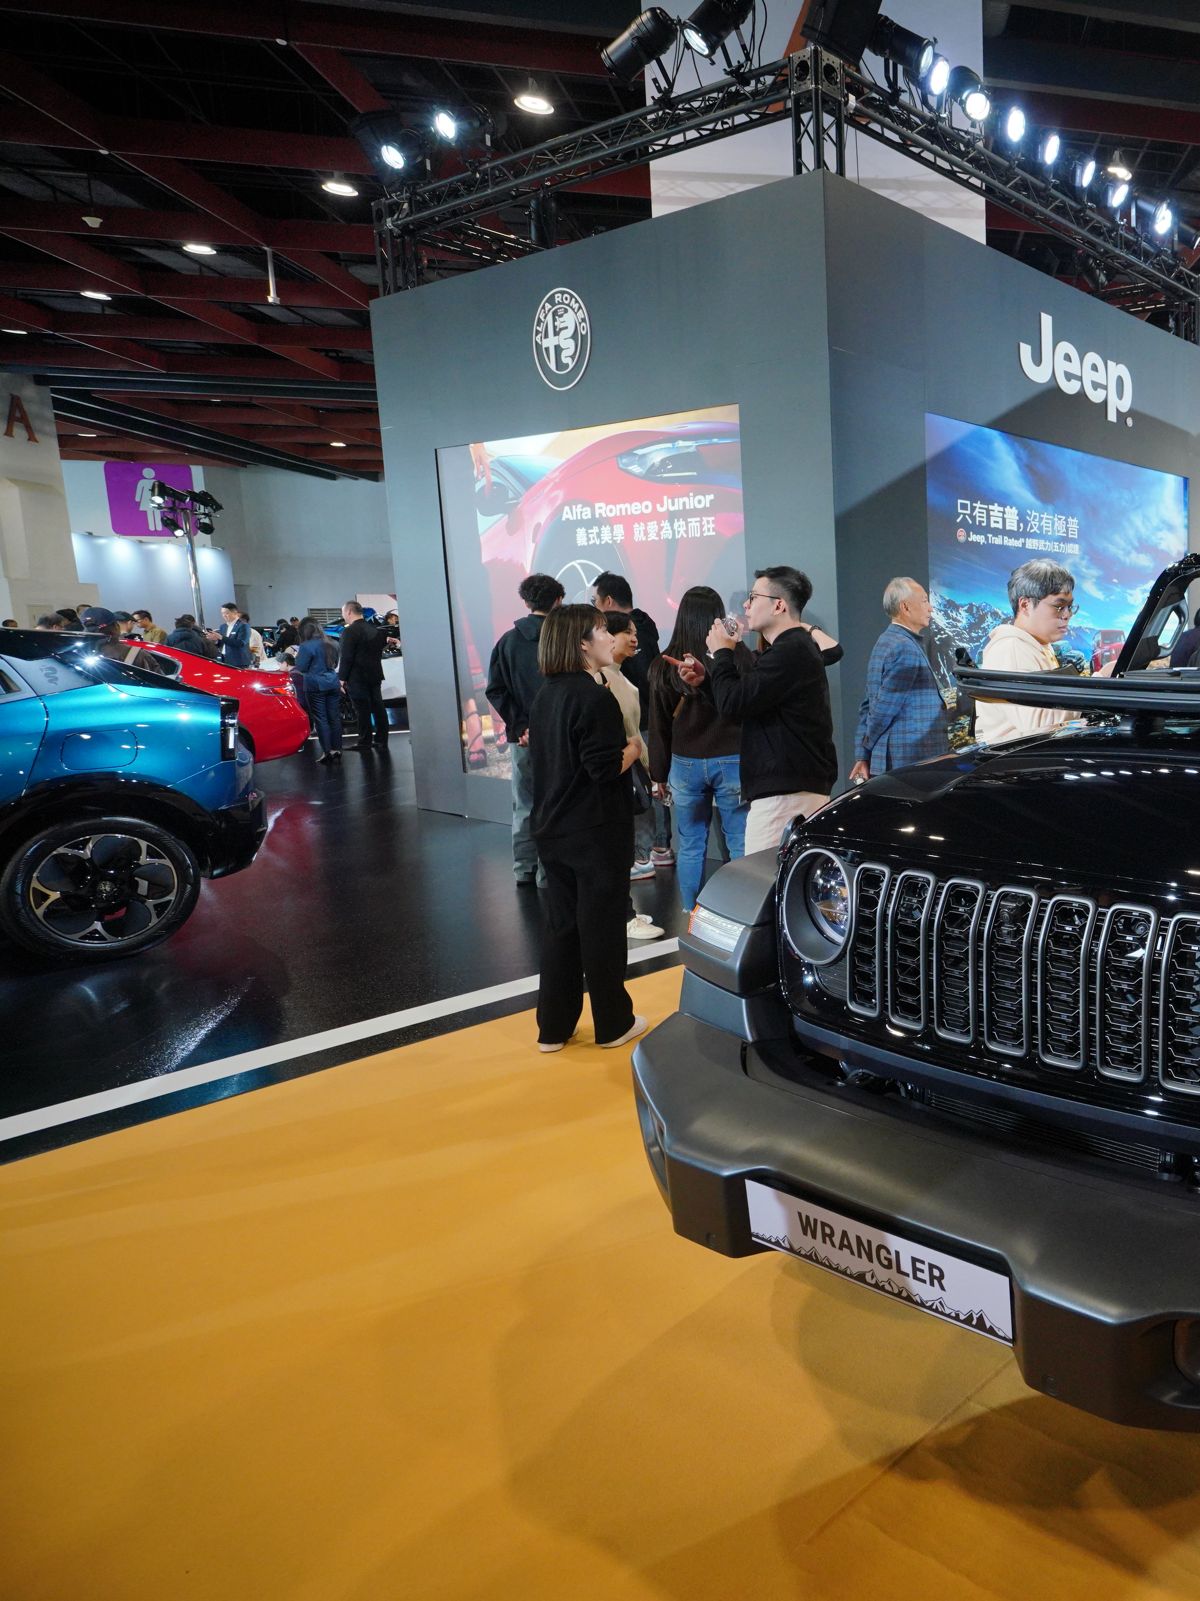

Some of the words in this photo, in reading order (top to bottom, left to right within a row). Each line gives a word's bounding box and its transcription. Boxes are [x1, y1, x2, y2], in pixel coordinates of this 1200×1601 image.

[536, 302, 552, 345] ALFA
[554, 293, 587, 336] ROMEO
[1019, 311, 1133, 424] Jeep
[4, 393, 39, 443] A
[562, 505, 592, 521] Alfa
[594, 501, 653, 519] Romeo
[656, 492, 714, 513] Junior
[575, 523, 625, 547] 義式美學
[632, 516, 716, 543] 就愛為快而狂
[987, 533, 1003, 545] Trail
[797, 1211, 946, 1292] WRANGLER
